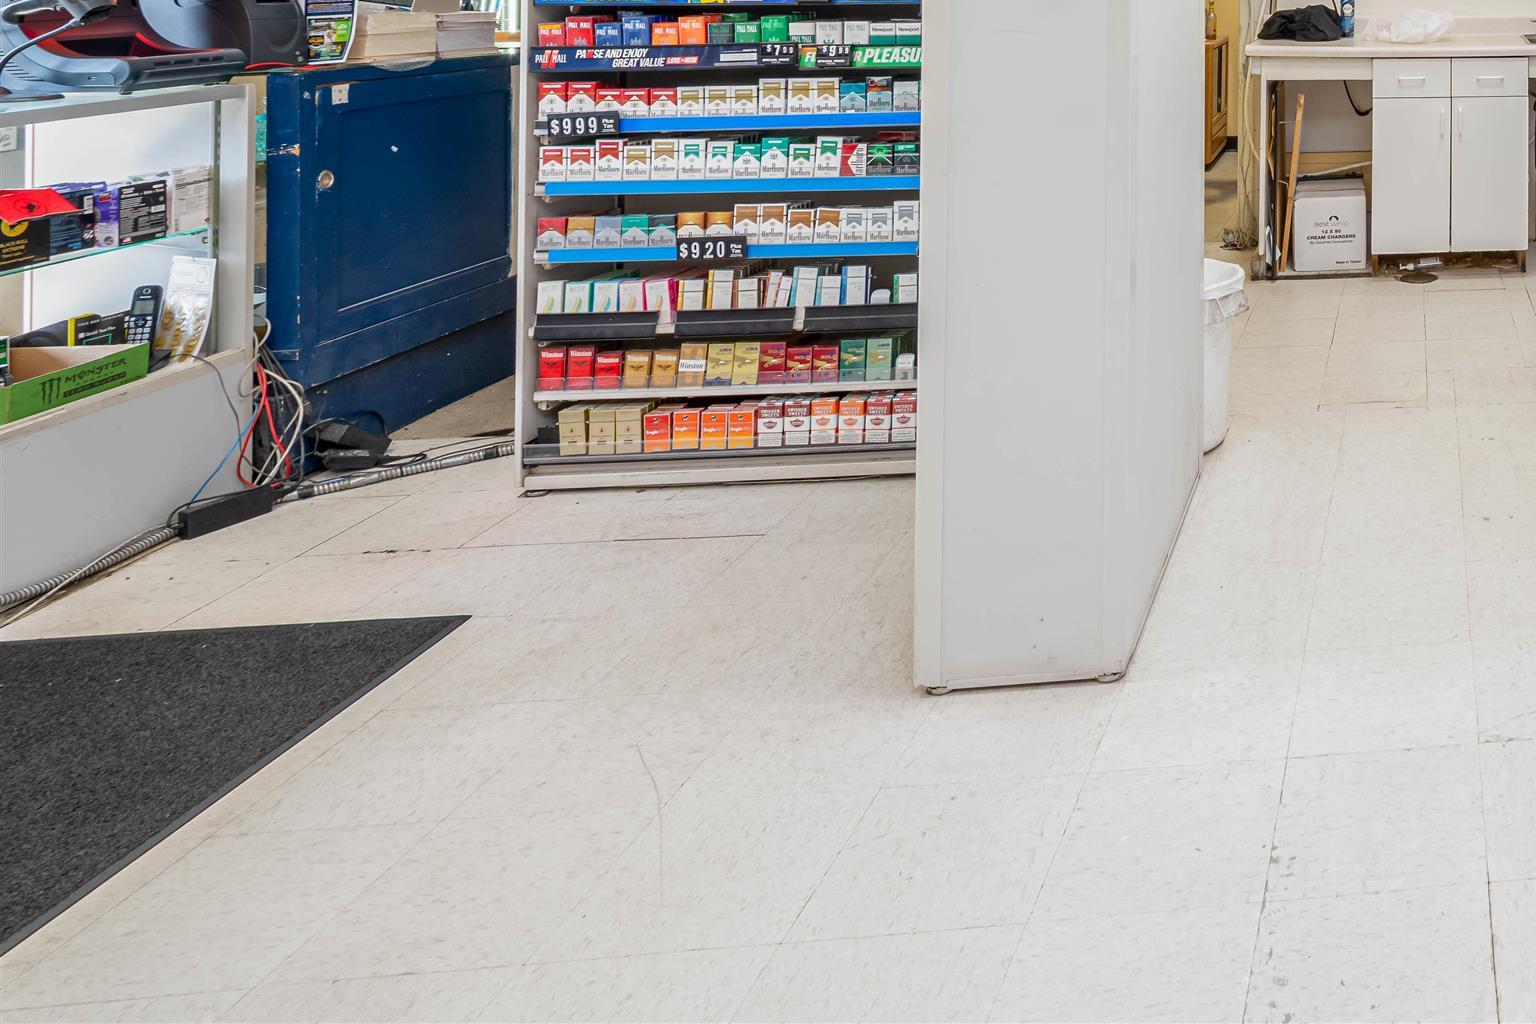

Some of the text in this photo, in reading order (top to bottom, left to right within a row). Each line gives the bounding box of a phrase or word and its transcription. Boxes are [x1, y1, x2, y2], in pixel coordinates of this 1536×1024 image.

[871, 26, 894, 35] Newport
[897, 26, 920, 35] Newport
[604, 48, 648, 59] AND ENJOY
[535, 53, 567, 64] PALL MALL
[612, 57, 665, 68] GREAT VALUE
[541, 351, 564, 359] Winston
[570, 350, 592, 358] Winston
[597, 356, 620, 365] Winston
[627, 355, 649, 363] Winston
[61, 357, 128, 384] MONSTER
